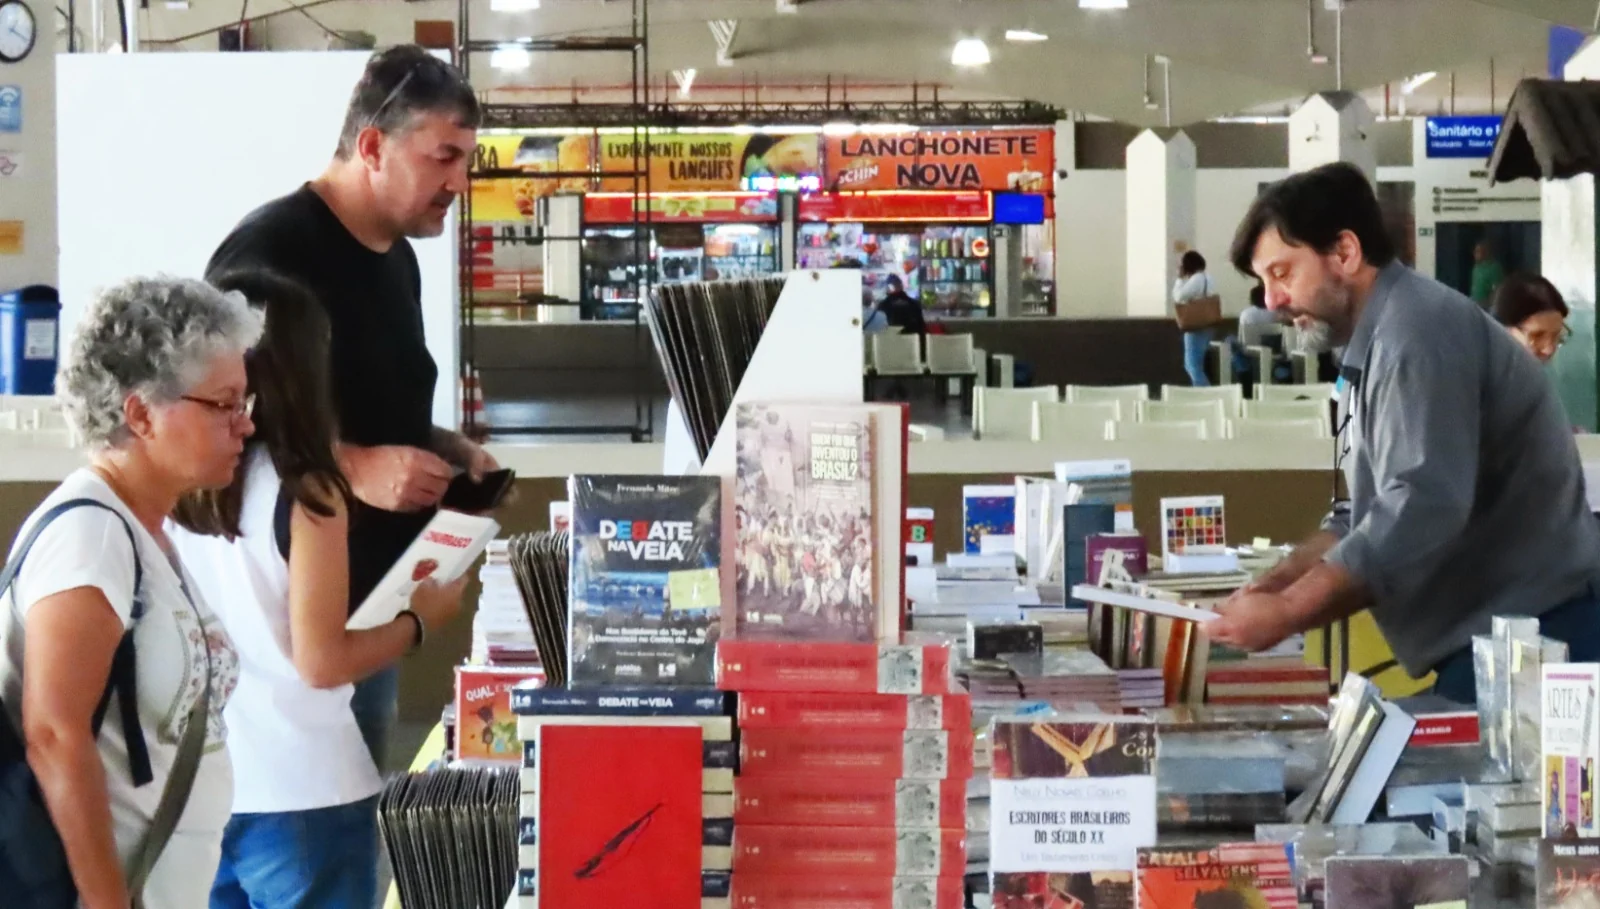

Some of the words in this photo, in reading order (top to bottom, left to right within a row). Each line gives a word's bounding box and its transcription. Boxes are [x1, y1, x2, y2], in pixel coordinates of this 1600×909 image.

[1430, 125, 1482, 137] Sanitário
[1485, 127, 1494, 136] e
[690, 142, 732, 158] NOSSOS
[841, 135, 1037, 157] LANCHONETE
[897, 163, 981, 187] NOVA
[811, 446, 850, 461] INVENTOU
[850, 448, 858, 461] O
[811, 460, 858, 481] BRASIL?
[617, 483, 655, 492] Fernando
[599, 519, 693, 541] DEBATE
[608, 541, 627, 551] NA
[627, 541, 684, 561] VEIA
[466, 684, 496, 702] QUAL
[598, 696, 639, 707] DEBATE
[648, 697, 673, 707] VEIA
[1546, 686, 1581, 720] ARTES
[1009, 810, 1066, 825] ESCRITORES
[1070, 810, 1131, 825] BRASILEIROS
[1034, 830, 1047, 843] DO
[1051, 828, 1087, 844] SÉCULO
[1090, 830, 1105, 844] XX
[1175, 865, 1259, 881] SELVAGENS
